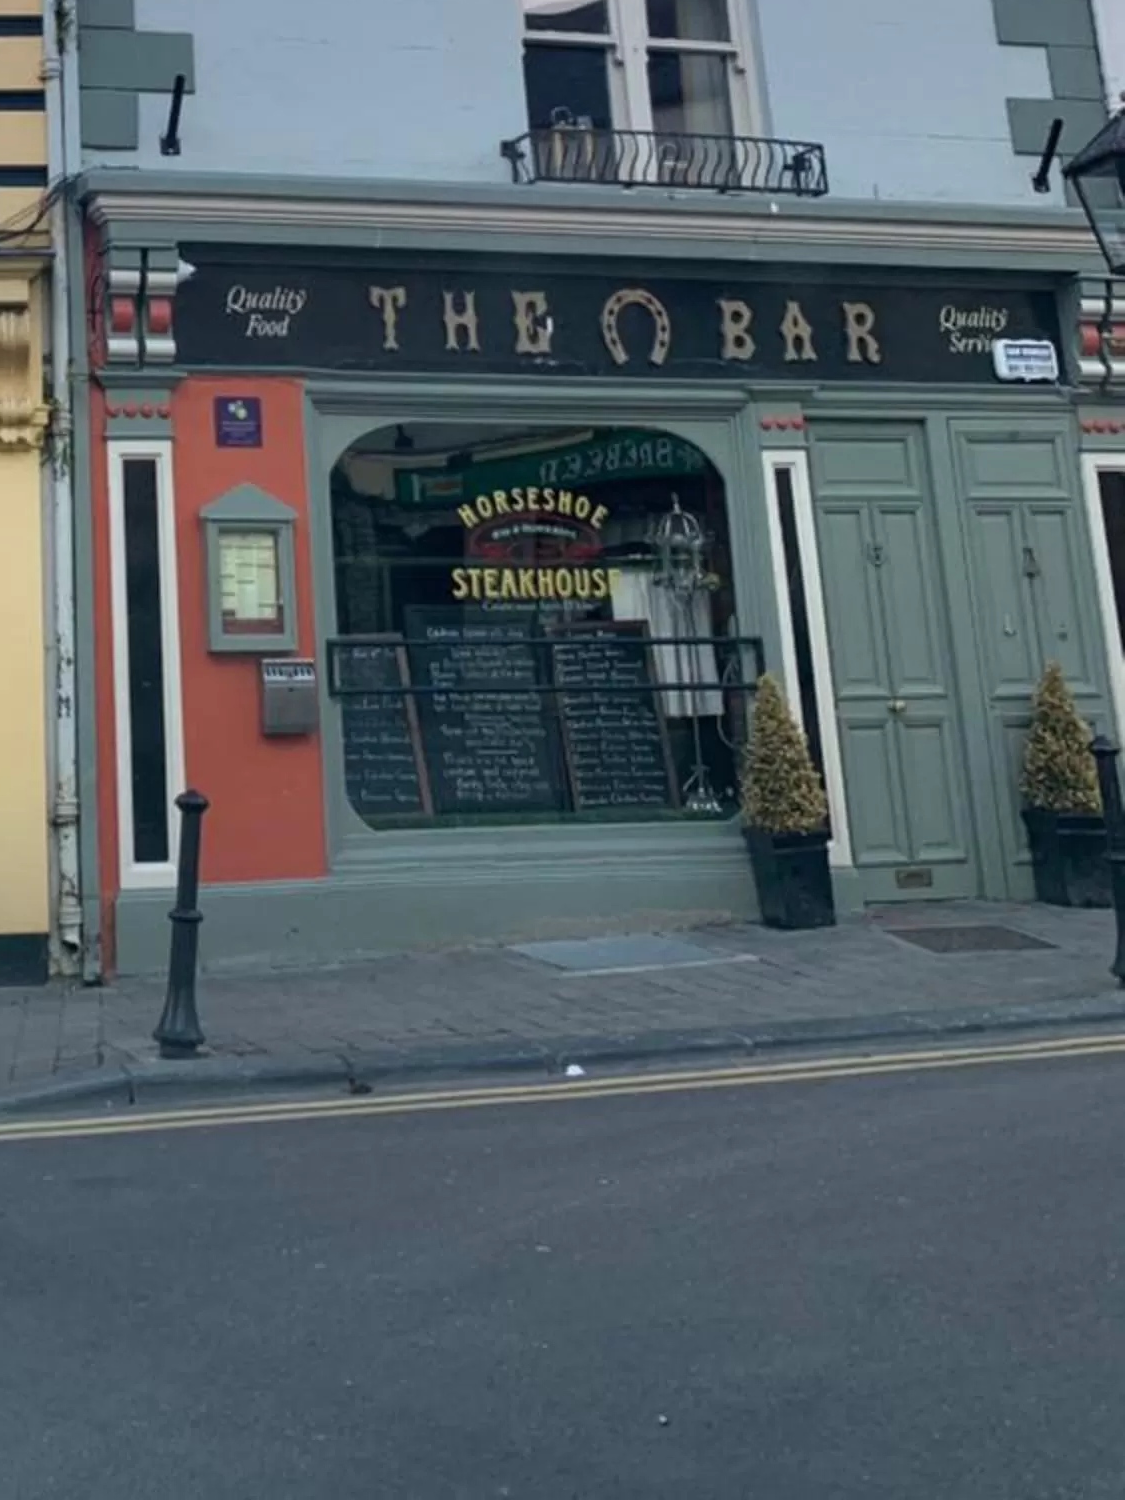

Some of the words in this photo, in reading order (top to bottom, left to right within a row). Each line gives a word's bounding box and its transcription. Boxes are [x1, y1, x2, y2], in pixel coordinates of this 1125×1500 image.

[225, 284, 308, 315] Quality
[245, 313, 291, 337] Food
[369, 286, 554, 355] THE
[717, 298, 882, 364] BAR
[939, 304, 1009, 332] Quality
[949, 331, 993, 354] Servi
[456, 486, 610, 530] HORSESHOE
[451, 567, 623, 600] STEAKHOUSE
